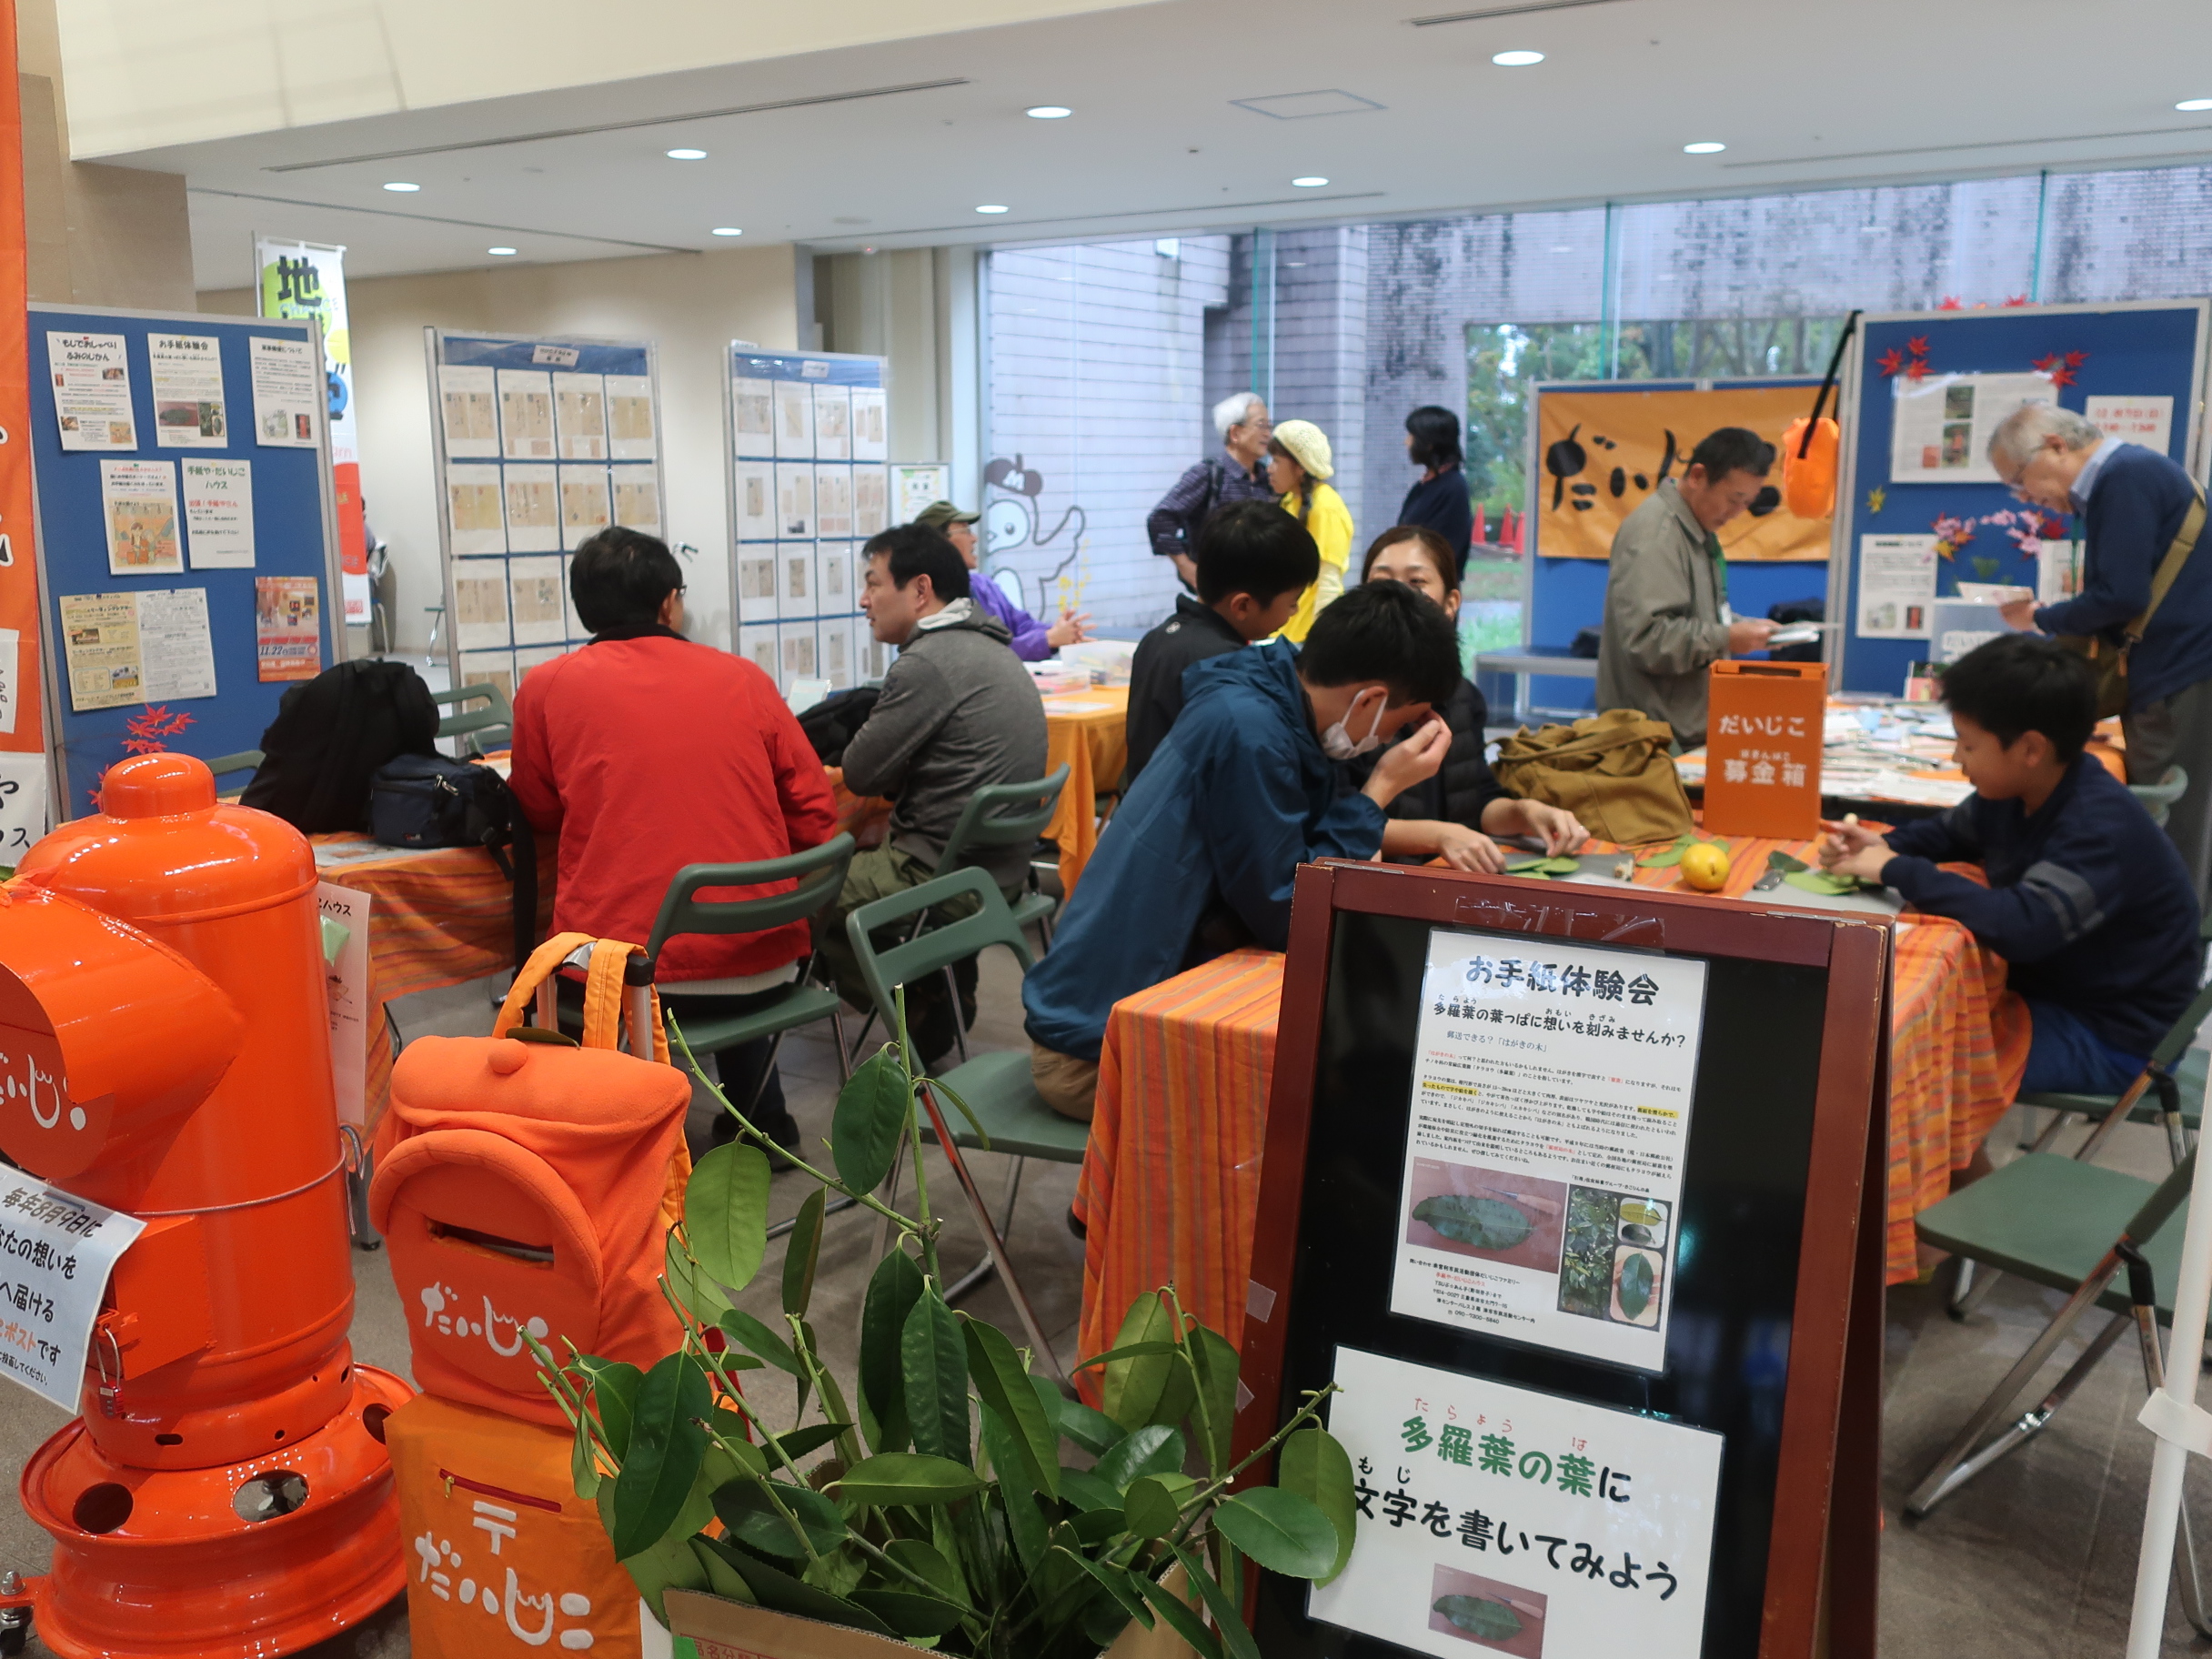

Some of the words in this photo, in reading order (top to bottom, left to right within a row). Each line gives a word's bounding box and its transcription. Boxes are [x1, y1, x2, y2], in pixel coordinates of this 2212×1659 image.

[277, 255, 322, 307] 地
[158, 339, 209, 351] お手紙体験会
[205, 480, 228, 489] ハウス
[1718, 714, 1806, 737] だいじこ
[1724, 759, 1807, 788] 募金箱
[1465, 953, 1660, 1006] お手紙体験会
[2, 1187, 103, 1238] 毎年8月9日に
[1358, 1456, 1411, 1484] もじ
[1401, 1415, 1632, 1503] 多羅葉の葉に
[1354, 1477, 1678, 1602] 文字を書いてみよう
